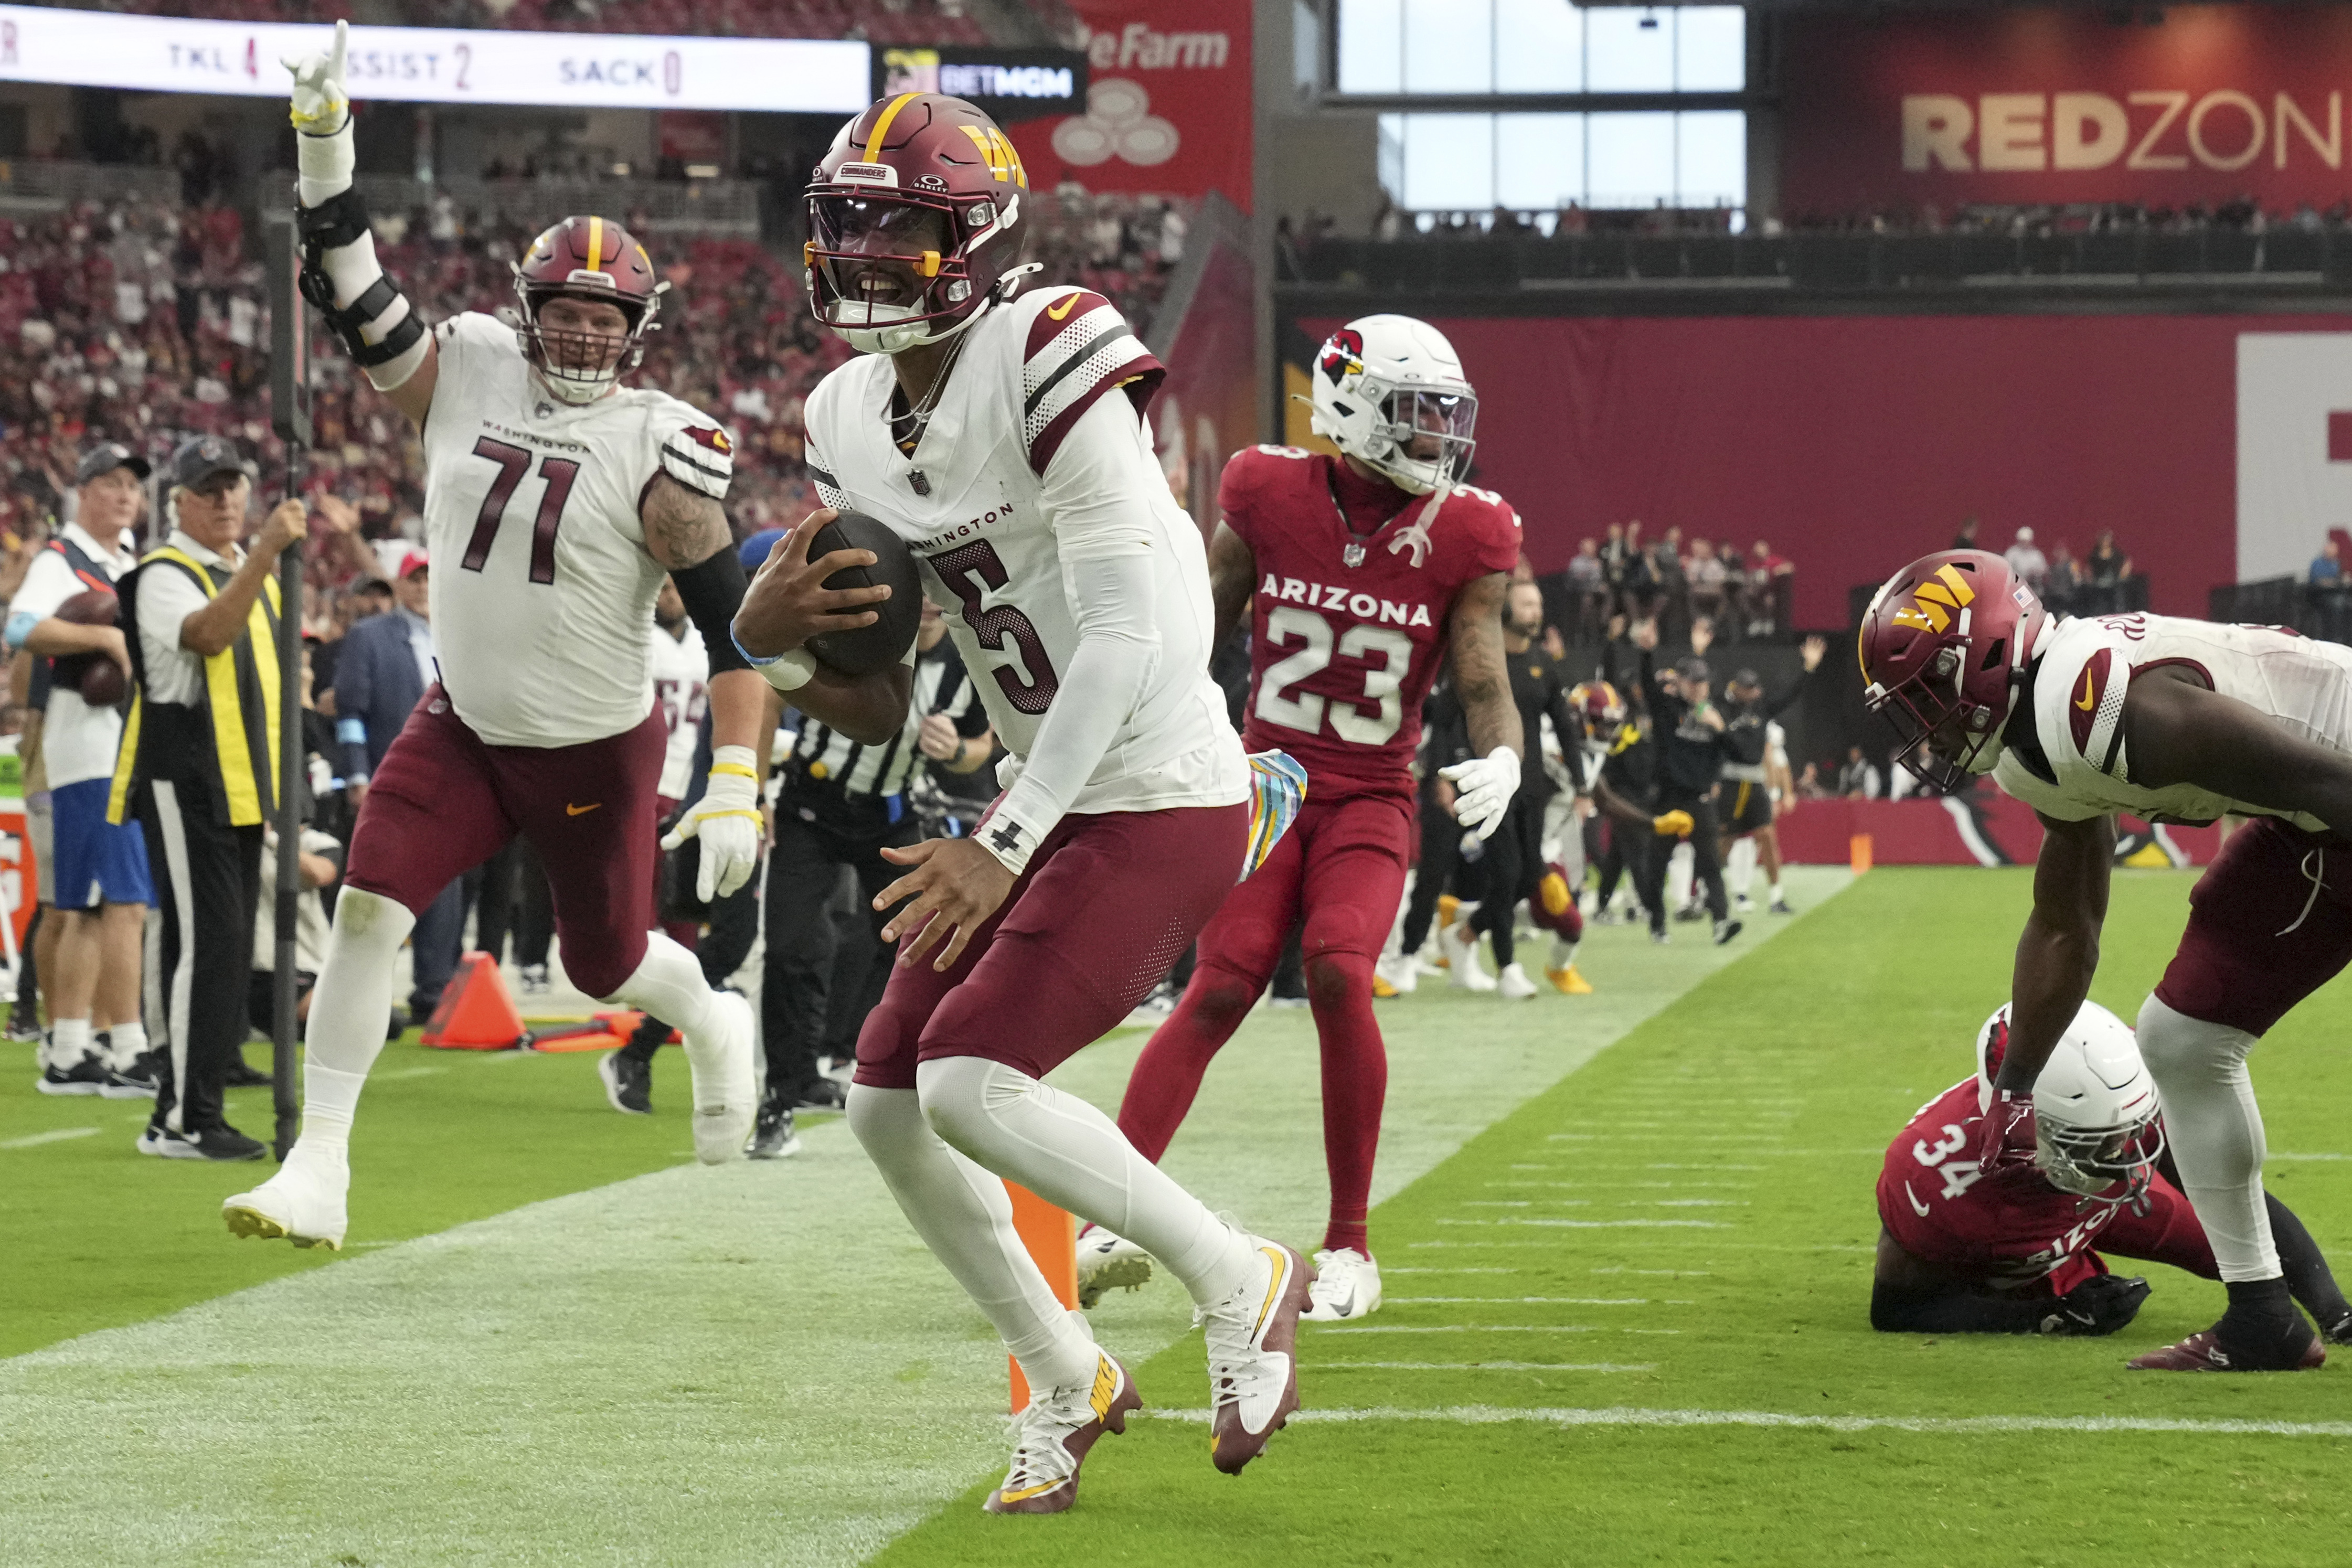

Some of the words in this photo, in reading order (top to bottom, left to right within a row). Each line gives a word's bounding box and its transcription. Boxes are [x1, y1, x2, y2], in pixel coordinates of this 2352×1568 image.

[169, 43, 230, 73] TKL
[243, 37, 258, 80] 4
[323, 49, 439, 80] SSIST
[453, 43, 472, 90] 2
[559, 57, 654, 85] SACK
[665, 50, 682, 95] 0
[941, 65, 1072, 99] BETMGM
[841, 167, 887, 177] COMMANDERS
[914, 183, 948, 192] OAKLEY
[483, 419, 590, 454] WASHINGTON
[460, 435, 581, 585] 71
[904, 503, 1014, 550] ASHINGTON
[1261, 573, 1432, 627] ARIZONA
[926, 537, 1059, 715] 5
[1254, 605, 1414, 746] 23
[1913, 1124, 1985, 1201] 34
